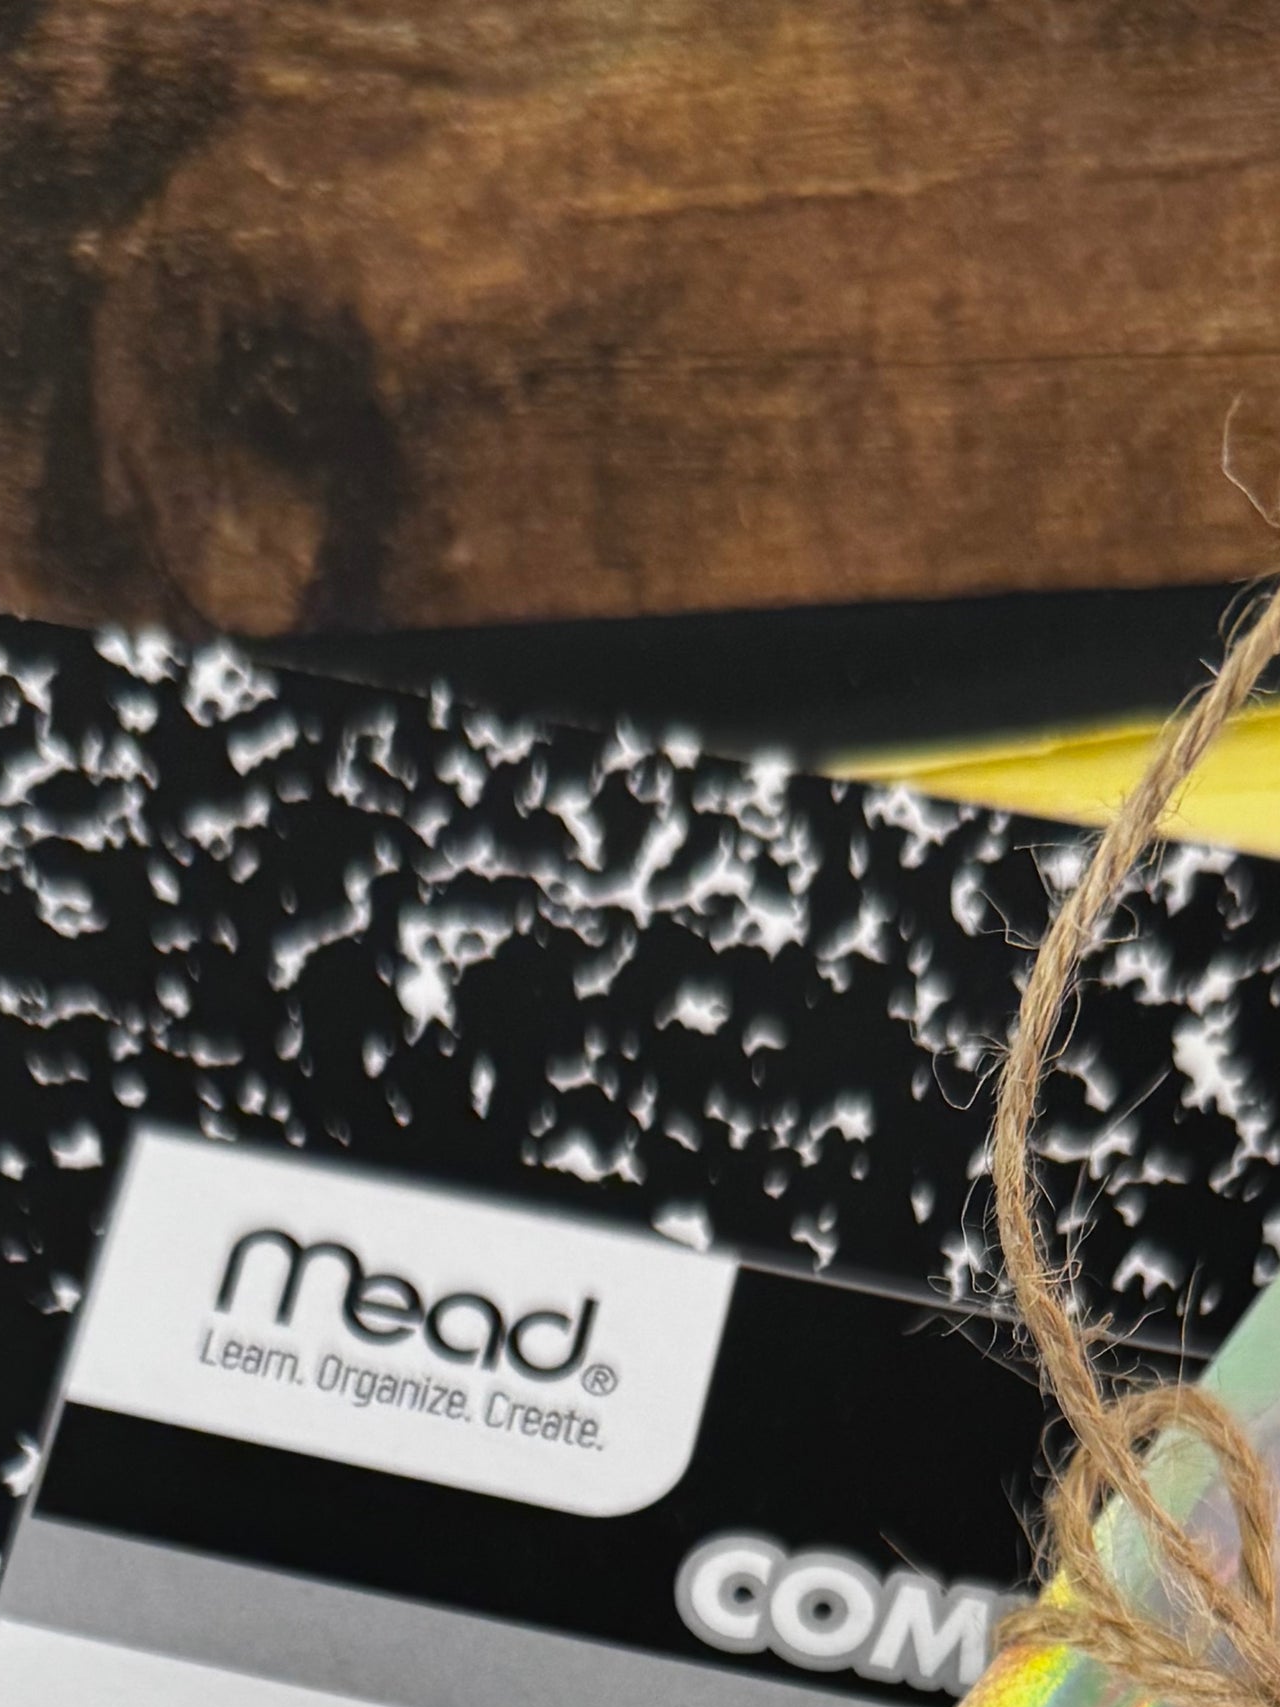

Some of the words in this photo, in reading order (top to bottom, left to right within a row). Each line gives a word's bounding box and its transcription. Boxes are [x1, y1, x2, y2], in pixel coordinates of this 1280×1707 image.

[199, 1328, 305, 1387] Learn.
[316, 1353, 472, 1423] Organize.
[483, 1390, 605, 1451] Create.
